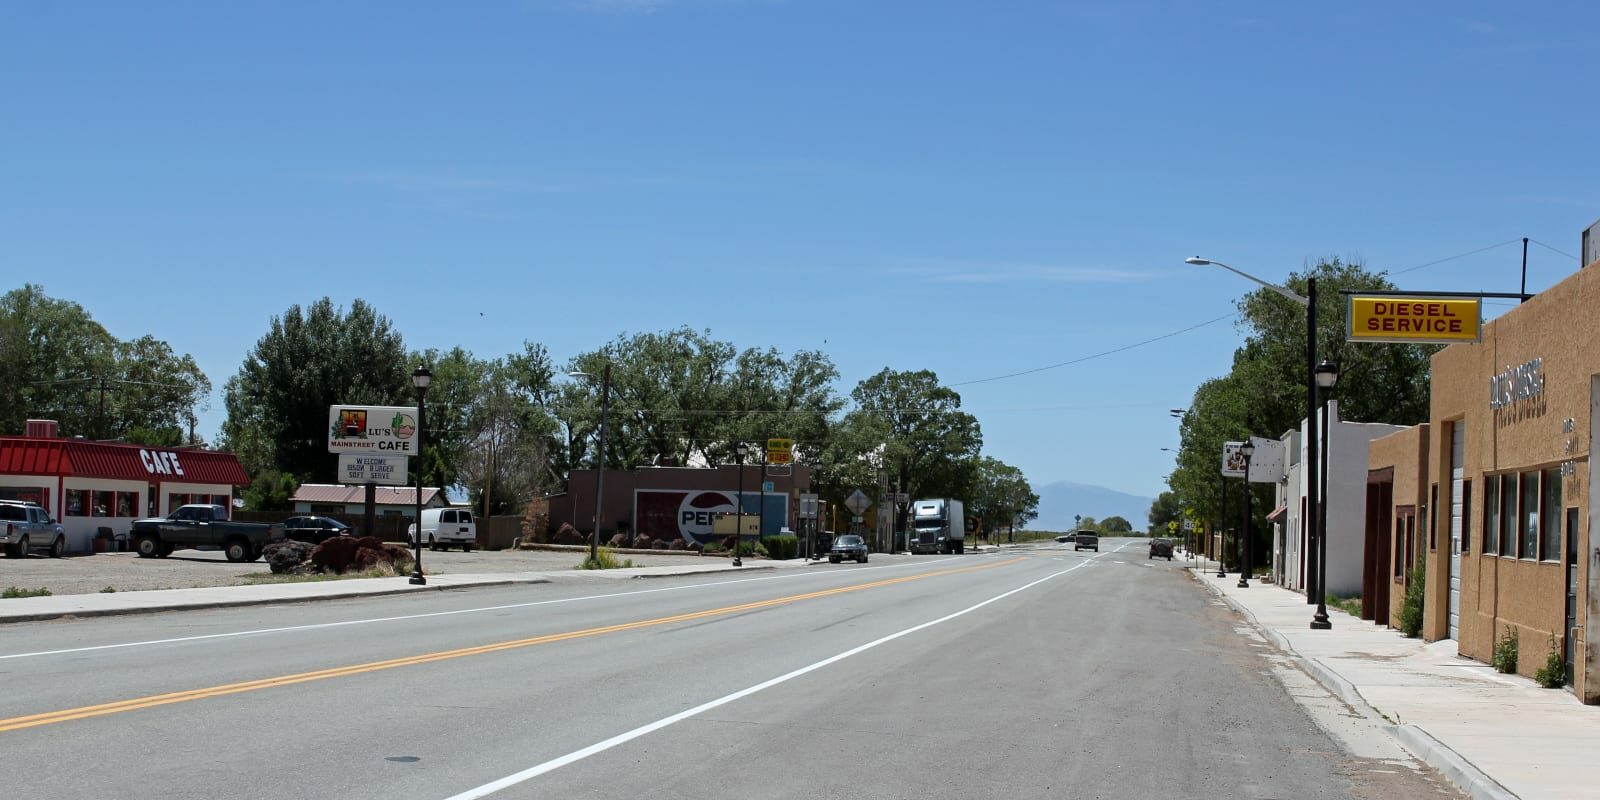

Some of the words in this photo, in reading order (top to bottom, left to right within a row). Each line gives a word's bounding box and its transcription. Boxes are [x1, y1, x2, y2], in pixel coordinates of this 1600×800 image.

[1374, 302, 1456, 317] DIESEL
[1367, 317, 1463, 333] SERVICE
[368, 428, 391, 436] LU'S
[330, 441, 376, 449] MAINSTREET
[378, 440, 410, 451] CAFE
[140, 449, 184, 476] CAFE
[682, 511, 713, 526] PE
